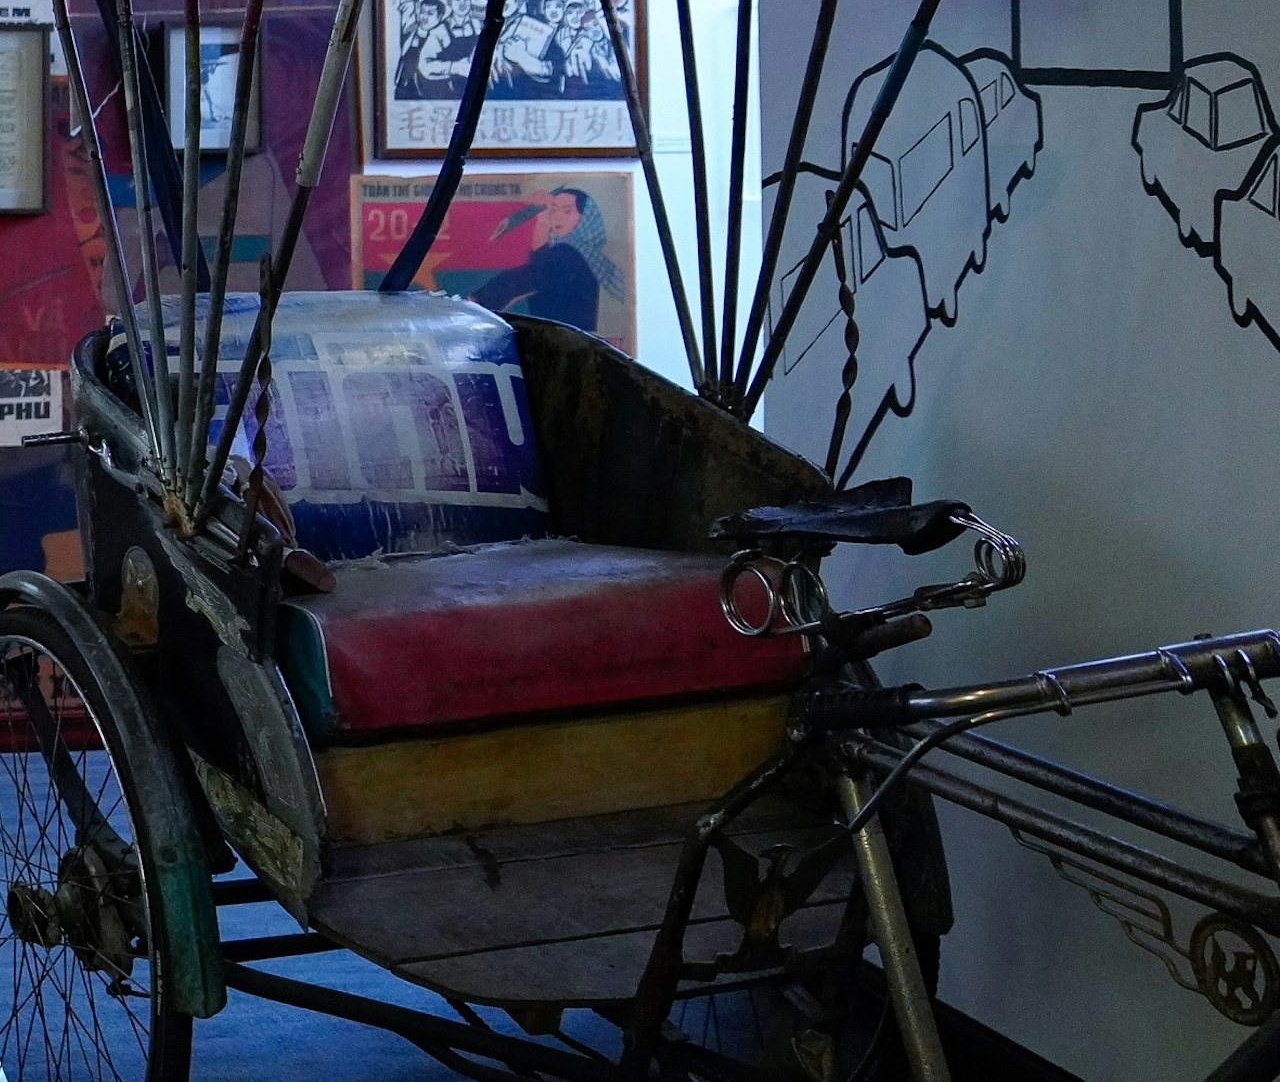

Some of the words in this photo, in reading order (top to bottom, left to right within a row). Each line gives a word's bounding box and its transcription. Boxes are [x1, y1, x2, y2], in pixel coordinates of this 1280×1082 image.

[398, 106, 624, 145] 毛泽思想万岁!
